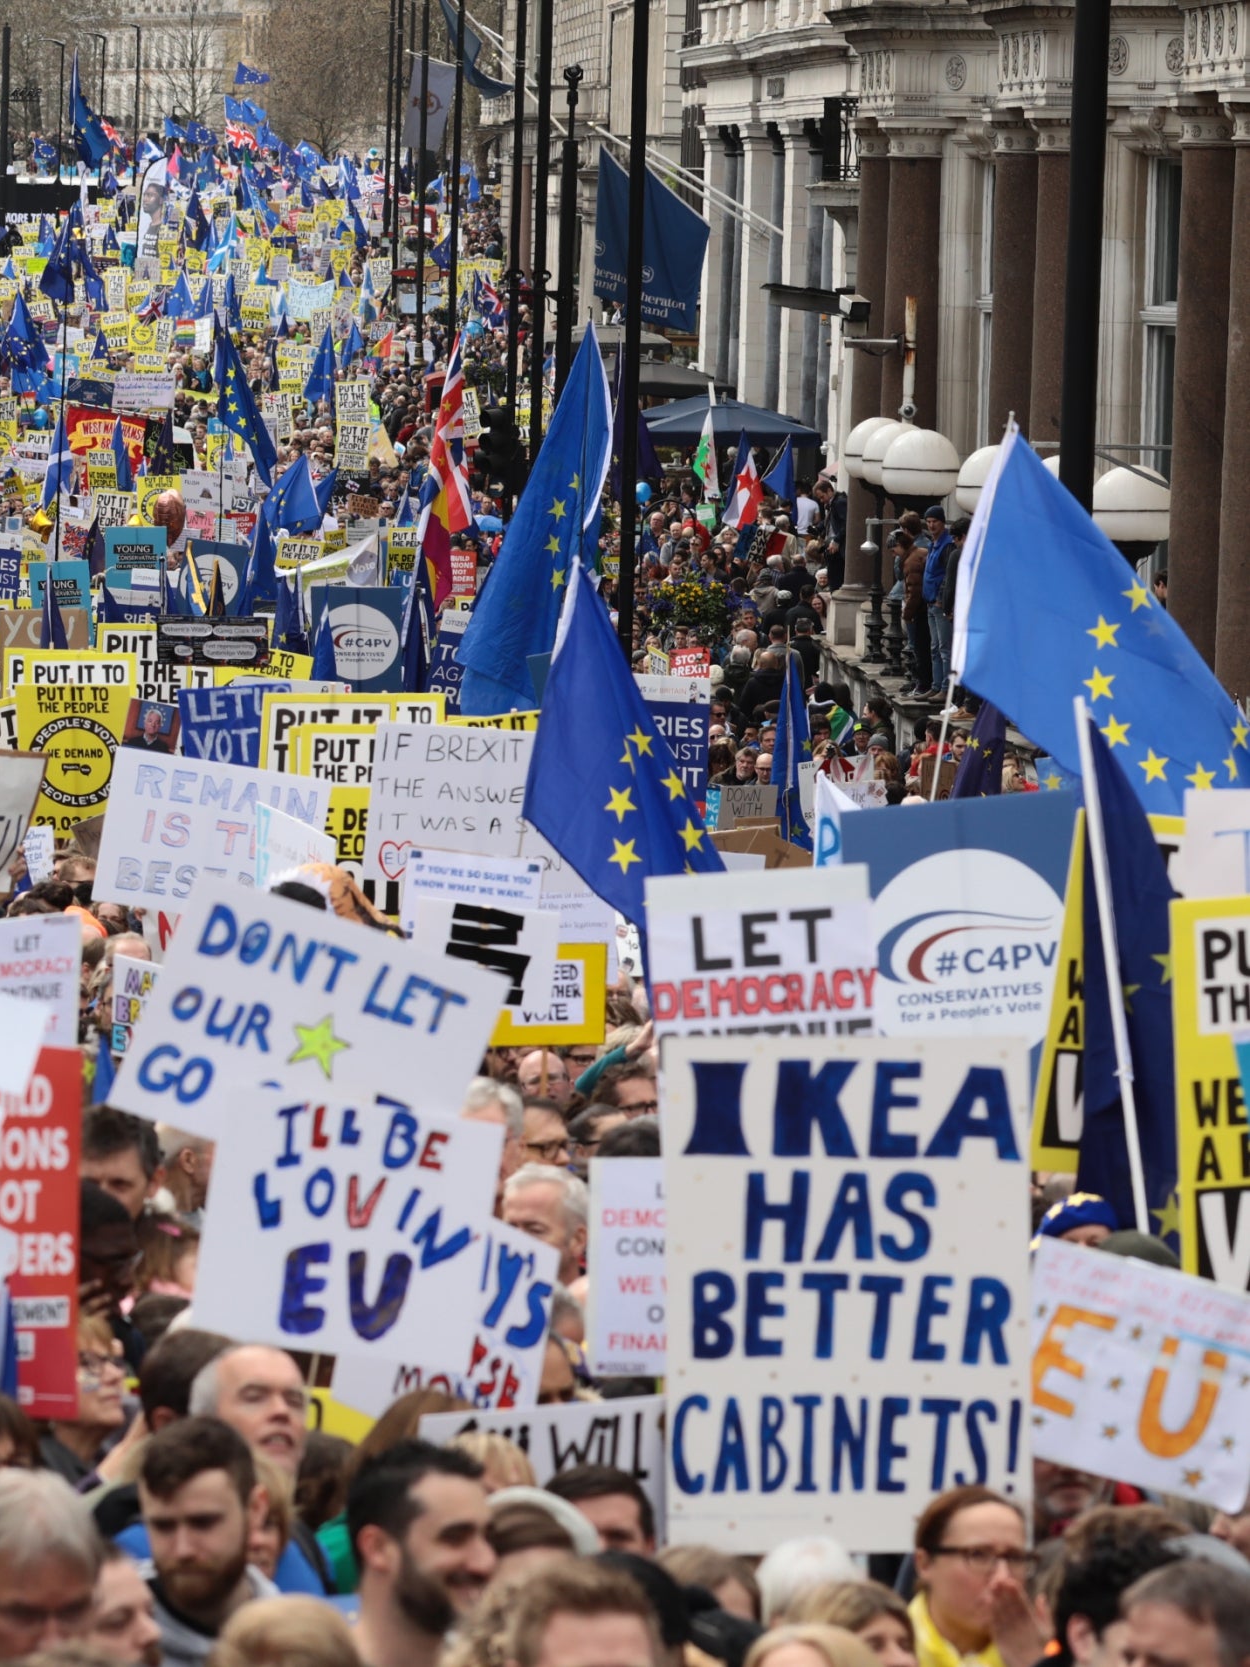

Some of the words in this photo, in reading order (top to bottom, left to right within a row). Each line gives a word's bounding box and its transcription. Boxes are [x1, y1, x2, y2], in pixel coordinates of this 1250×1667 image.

[5, 212, 29, 223] MORE
[243, 320, 264, 328] VOTE
[339, 400, 366, 408] PEOPLE
[340, 426, 358, 435] PUT
[360, 427, 369, 436] IT
[339, 442, 367, 450] PEOPLE
[99, 515, 126, 526] EOPLE
[116, 545, 151, 553] YOUNG
[389, 553, 399, 561] WE
[351, 561, 376, 574] Vote
[40, 580, 74, 590] YUNG
[191, 625, 212, 634] Wally?
[107, 634, 153, 658] PUT
[344, 637, 392, 648] #C4PV
[279, 653, 295, 668] TO
[675, 652, 703, 666] STOP
[34, 665, 70, 684] PUT
[77, 665, 95, 684] IT
[101, 664, 125, 684] TO
[670, 663, 709, 677] BREXIT
[36, 687, 66, 701] PUT
[69, 687, 85, 701] IT
[90, 687, 109, 701] TO
[38, 702, 60, 713] THE
[64, 702, 110, 713] PEOPLE
[186, 687, 253, 724] LET
[35, 718, 92, 745] PEOPLE'S
[93, 725, 119, 752] VOTE
[64, 748, 104, 758] DEMAND
[381, 732, 413, 762] IF
[425, 733, 524, 763] BREXIT
[133, 763, 319, 825] REMAIN
[378, 777, 426, 798] THE
[438, 781, 526, 804] ANSWE
[726, 787, 762, 802] DOWN
[731, 802, 763, 816] WITH
[141, 809, 192, 848] IS
[378, 812, 409, 831] IT
[420, 815, 476, 831] WAS
[489, 817, 502, 834] A
[415, 863, 426, 873] IF
[427, 865, 465, 879] YOU'RE
[467, 869, 481, 880] SO
[482, 871, 510, 883] SURE
[512, 874, 533, 885] YOU
[13, 934, 42, 953] LET
[690, 907, 832, 971] LET
[197, 902, 359, 995] DON'T
[361, 964, 470, 1034] LET
[935, 940, 1058, 977] #C4PV
[650, 967, 878, 1022] DEMOCRACY
[897, 982, 1044, 1007] CONSERVATIVES
[169, 986, 272, 1054] OUR
[901, 1010, 922, 1023] for
[926, 1011, 936, 1021] a
[940, 1003, 1004, 1020] People's
[1007, 1001, 1042, 1013] Vote
[136, 1042, 214, 1105] GO
[681, 1058, 1022, 1161] IKEA
[1196, 1134, 1223, 1182] A
[743, 1170, 938, 1264] HAS
[277, 1242, 414, 1342] EU
[618, 1275, 653, 1295] WE
[691, 1271, 1013, 1367] BETTER
[671, 1394, 1023, 1495] CABINETS!
